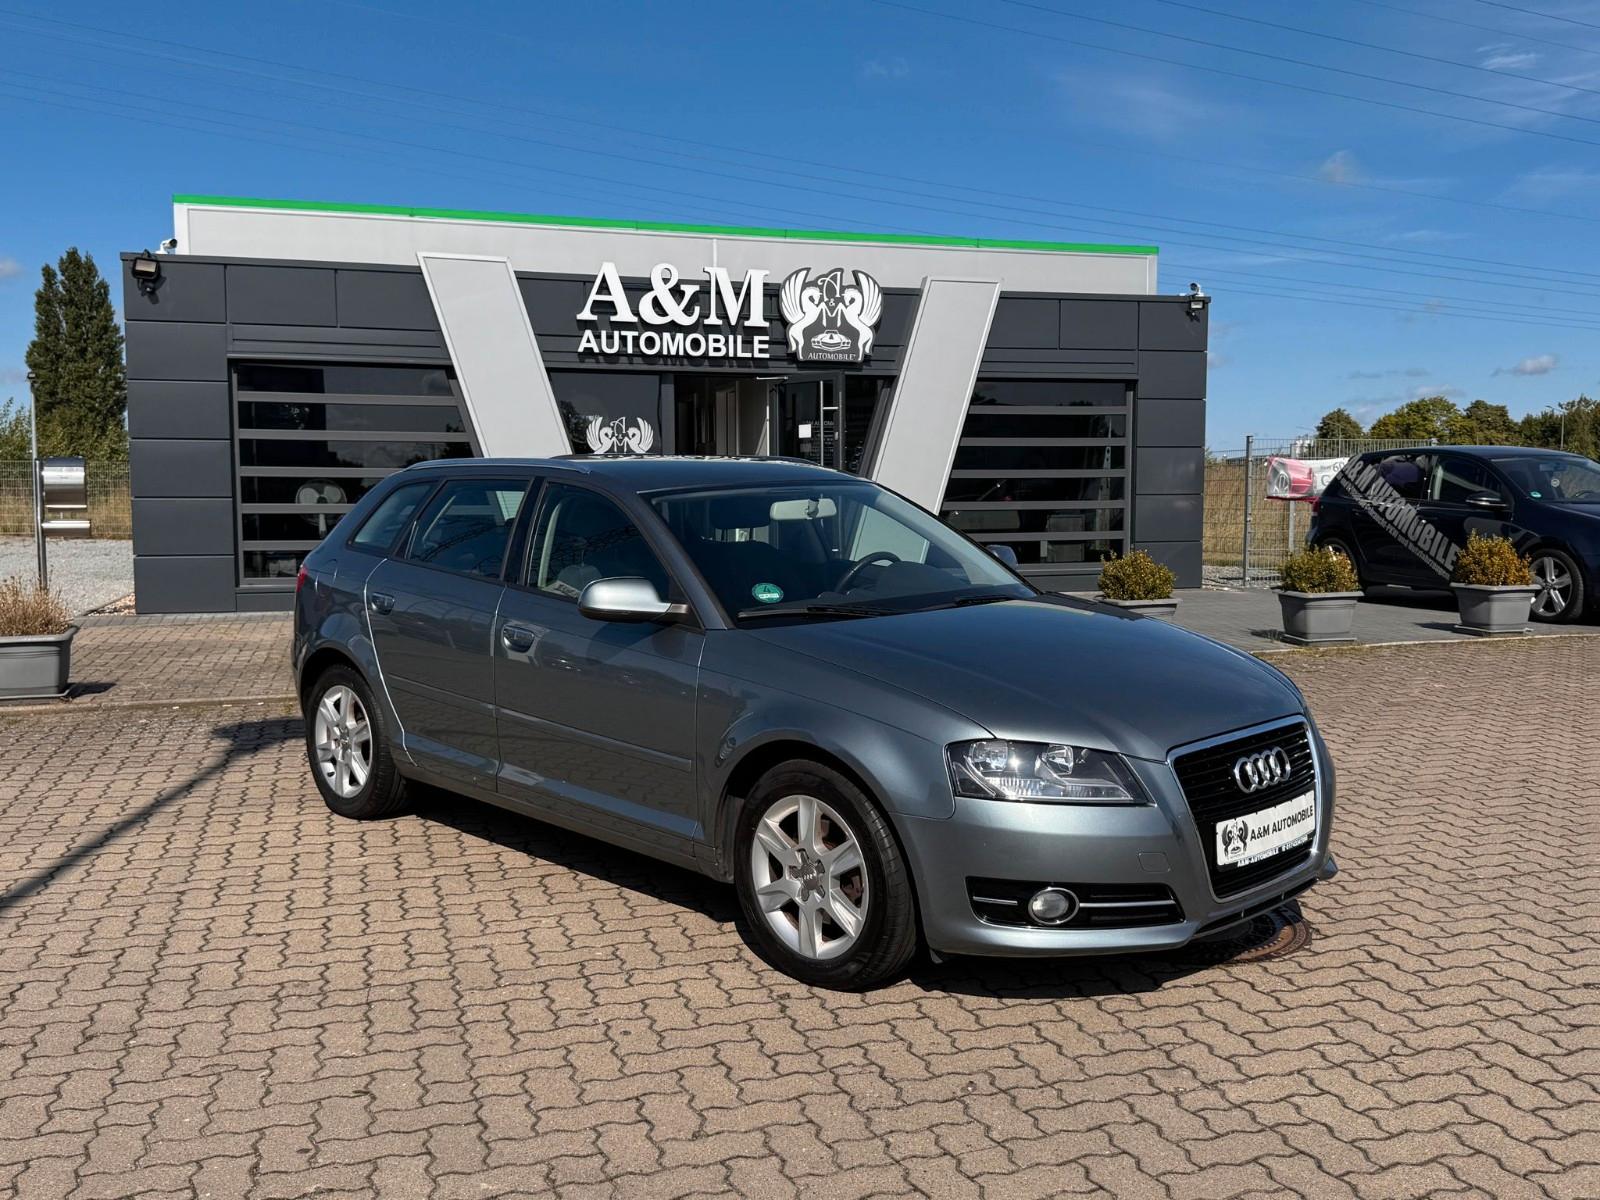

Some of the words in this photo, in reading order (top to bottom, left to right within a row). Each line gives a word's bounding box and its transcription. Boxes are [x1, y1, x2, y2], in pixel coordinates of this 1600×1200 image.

[576, 262, 770, 327] A&M
[577, 329, 770, 359] AUTOMOBILE
[1365, 476, 1462, 572] AUTOMOBILE
[1249, 823, 1270, 842] A&M
[1272, 805, 1313, 834] AUTOMOBILE
